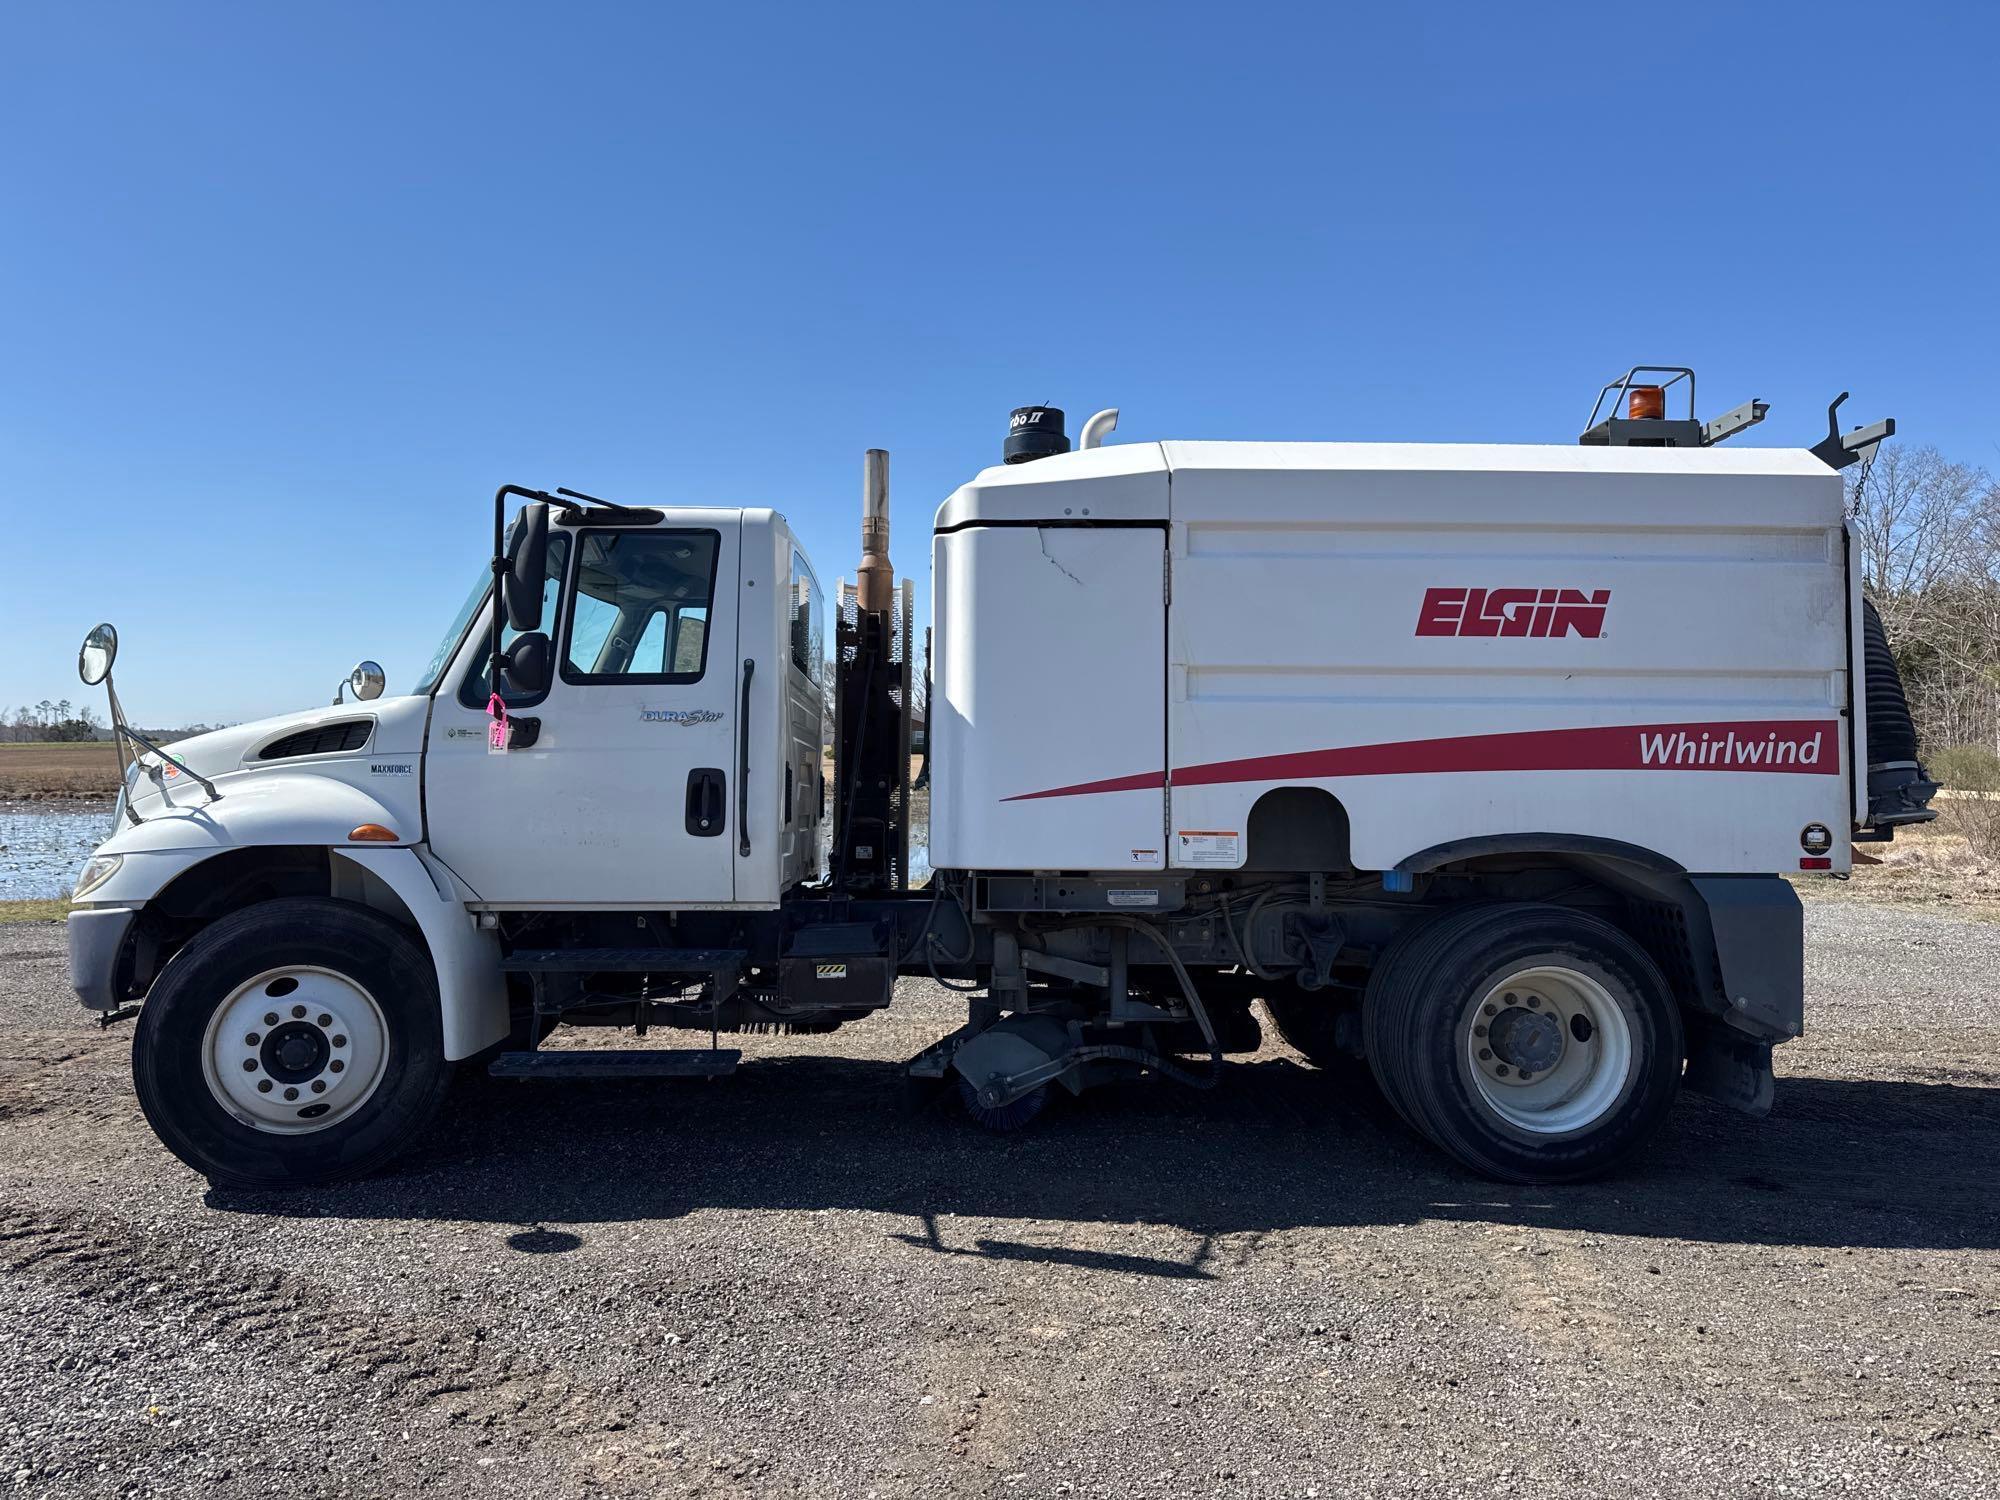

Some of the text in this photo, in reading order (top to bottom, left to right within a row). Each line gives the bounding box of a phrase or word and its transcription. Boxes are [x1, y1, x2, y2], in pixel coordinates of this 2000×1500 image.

[1028, 412, 1044, 423] II
[1414, 587, 1611, 638] ELGIN
[1639, 731, 1822, 764] Whirlwind
[370, 764, 413, 774] MAXXFORCE
